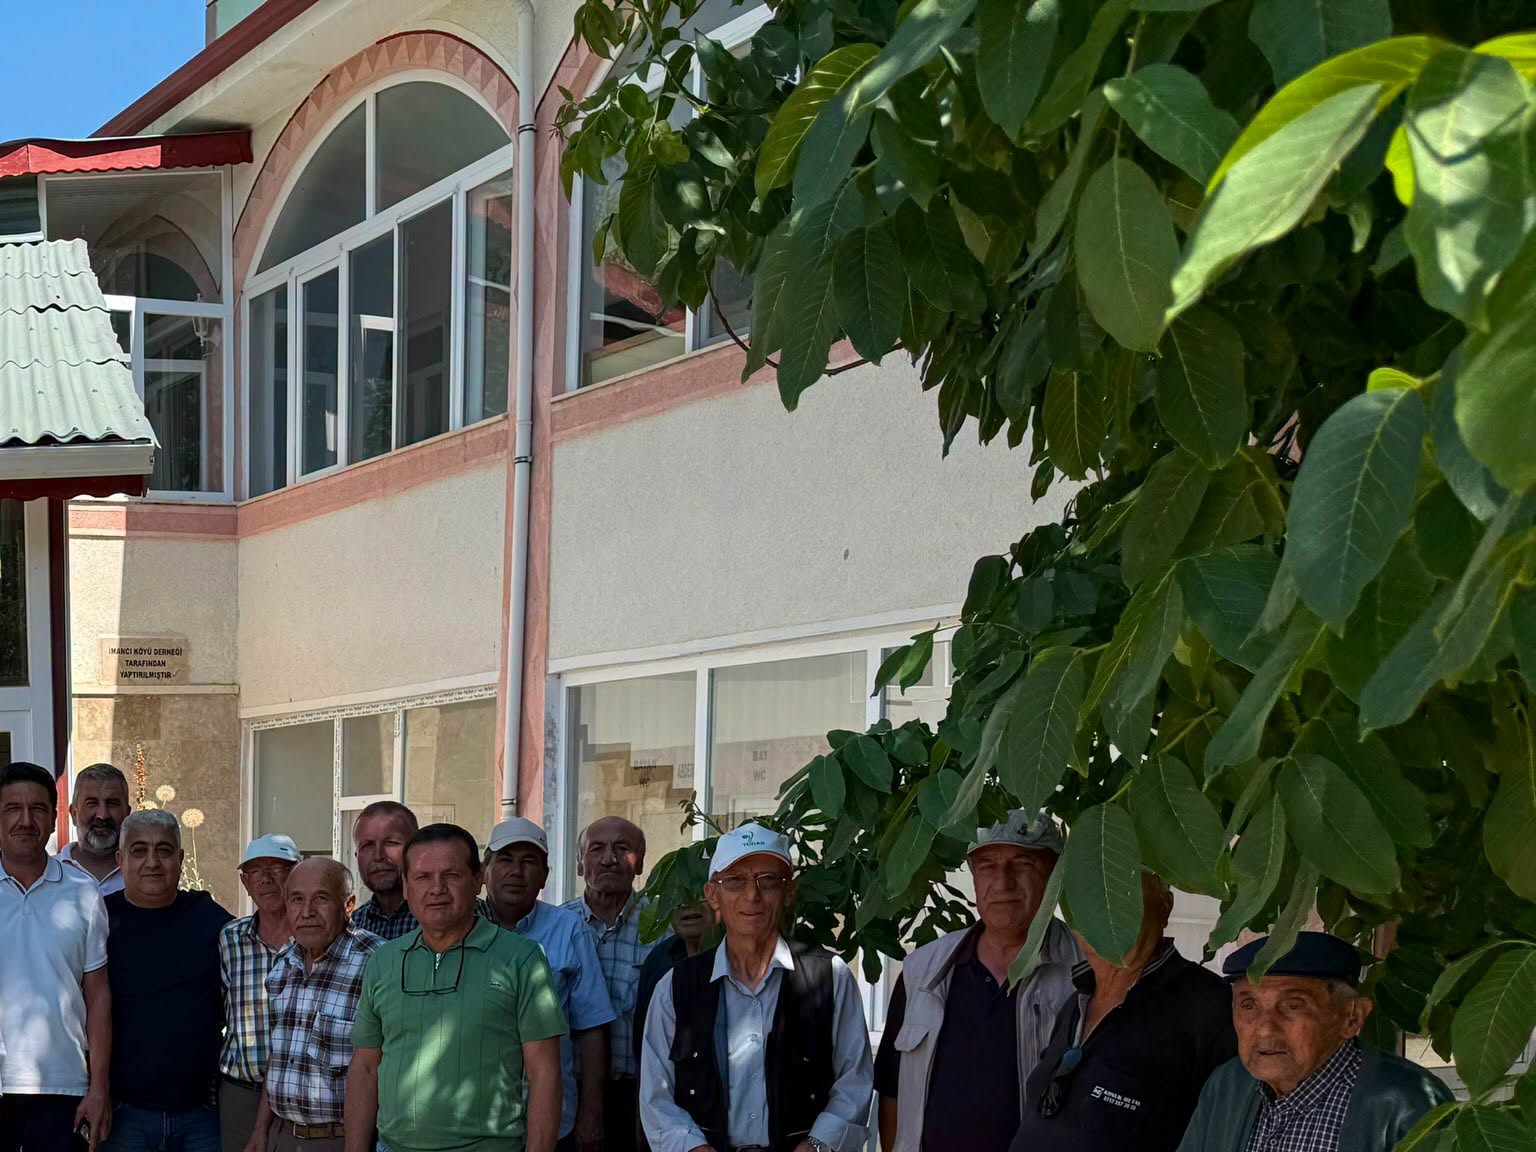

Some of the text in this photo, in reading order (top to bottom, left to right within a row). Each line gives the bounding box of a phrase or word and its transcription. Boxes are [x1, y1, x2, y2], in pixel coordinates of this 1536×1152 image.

[108, 647, 132, 655] İMANCI
[134, 647, 152, 656] KÖYÜ
[753, 769, 766, 782] WC
